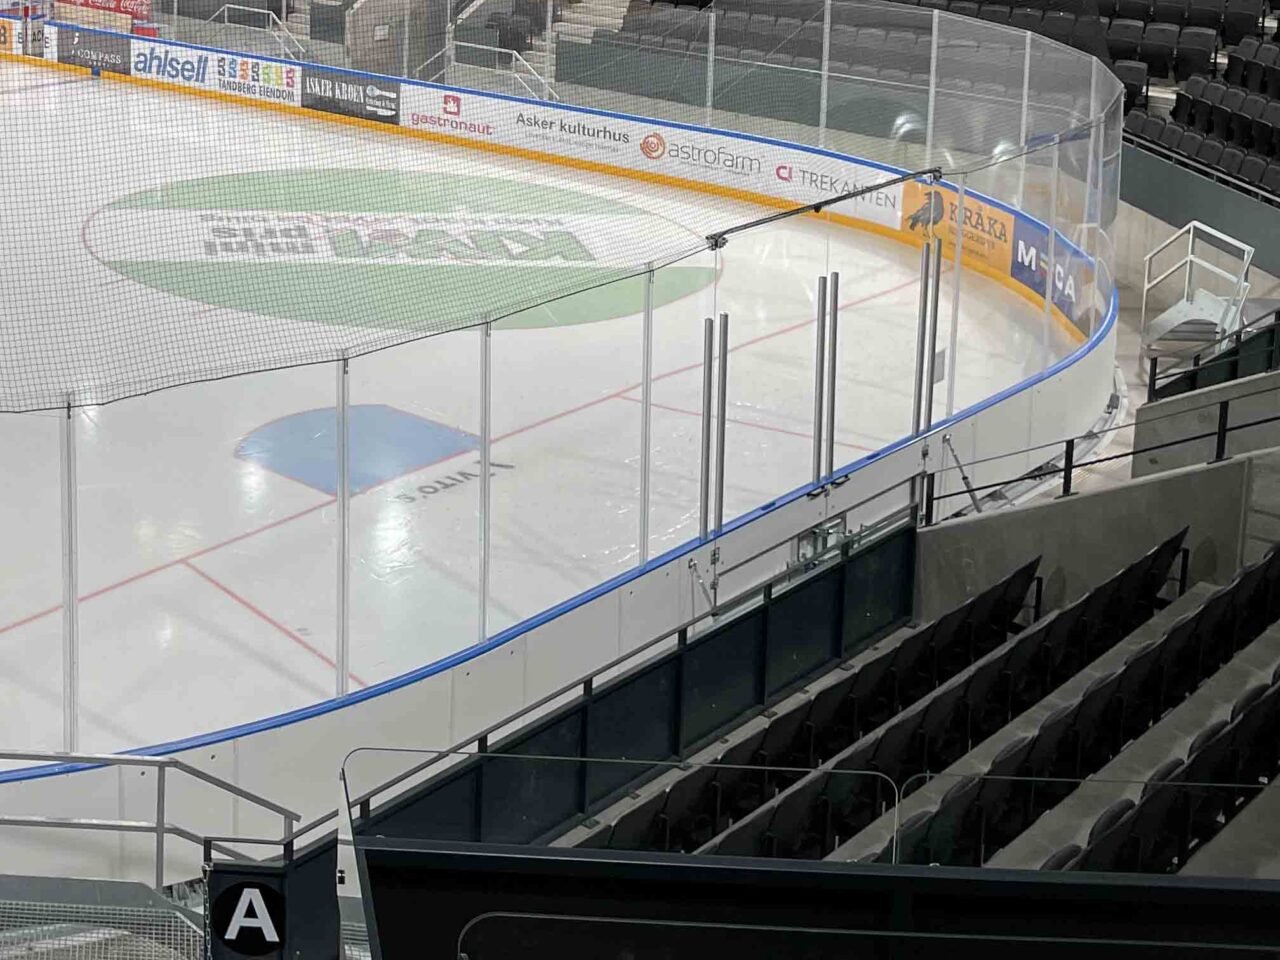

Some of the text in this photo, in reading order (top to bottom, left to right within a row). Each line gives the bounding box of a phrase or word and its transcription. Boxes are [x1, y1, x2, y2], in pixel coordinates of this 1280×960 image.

[77, 48, 122, 65] COMPASS
[133, 47, 209, 84] ahlsell
[218, 78, 295, 103] TANDBERG EIENDOM
[304, 76, 333, 98] ASKER
[411, 111, 494, 137] gastronaut
[516, 112, 556, 130] Asker
[560, 118, 630, 144] kulturhus
[668, 143, 761, 174] astrofarm
[799, 169, 897, 209] TREKANTEN
[949, 201, 1008, 244] KRÅKA
[224, 887, 280, 943] A
